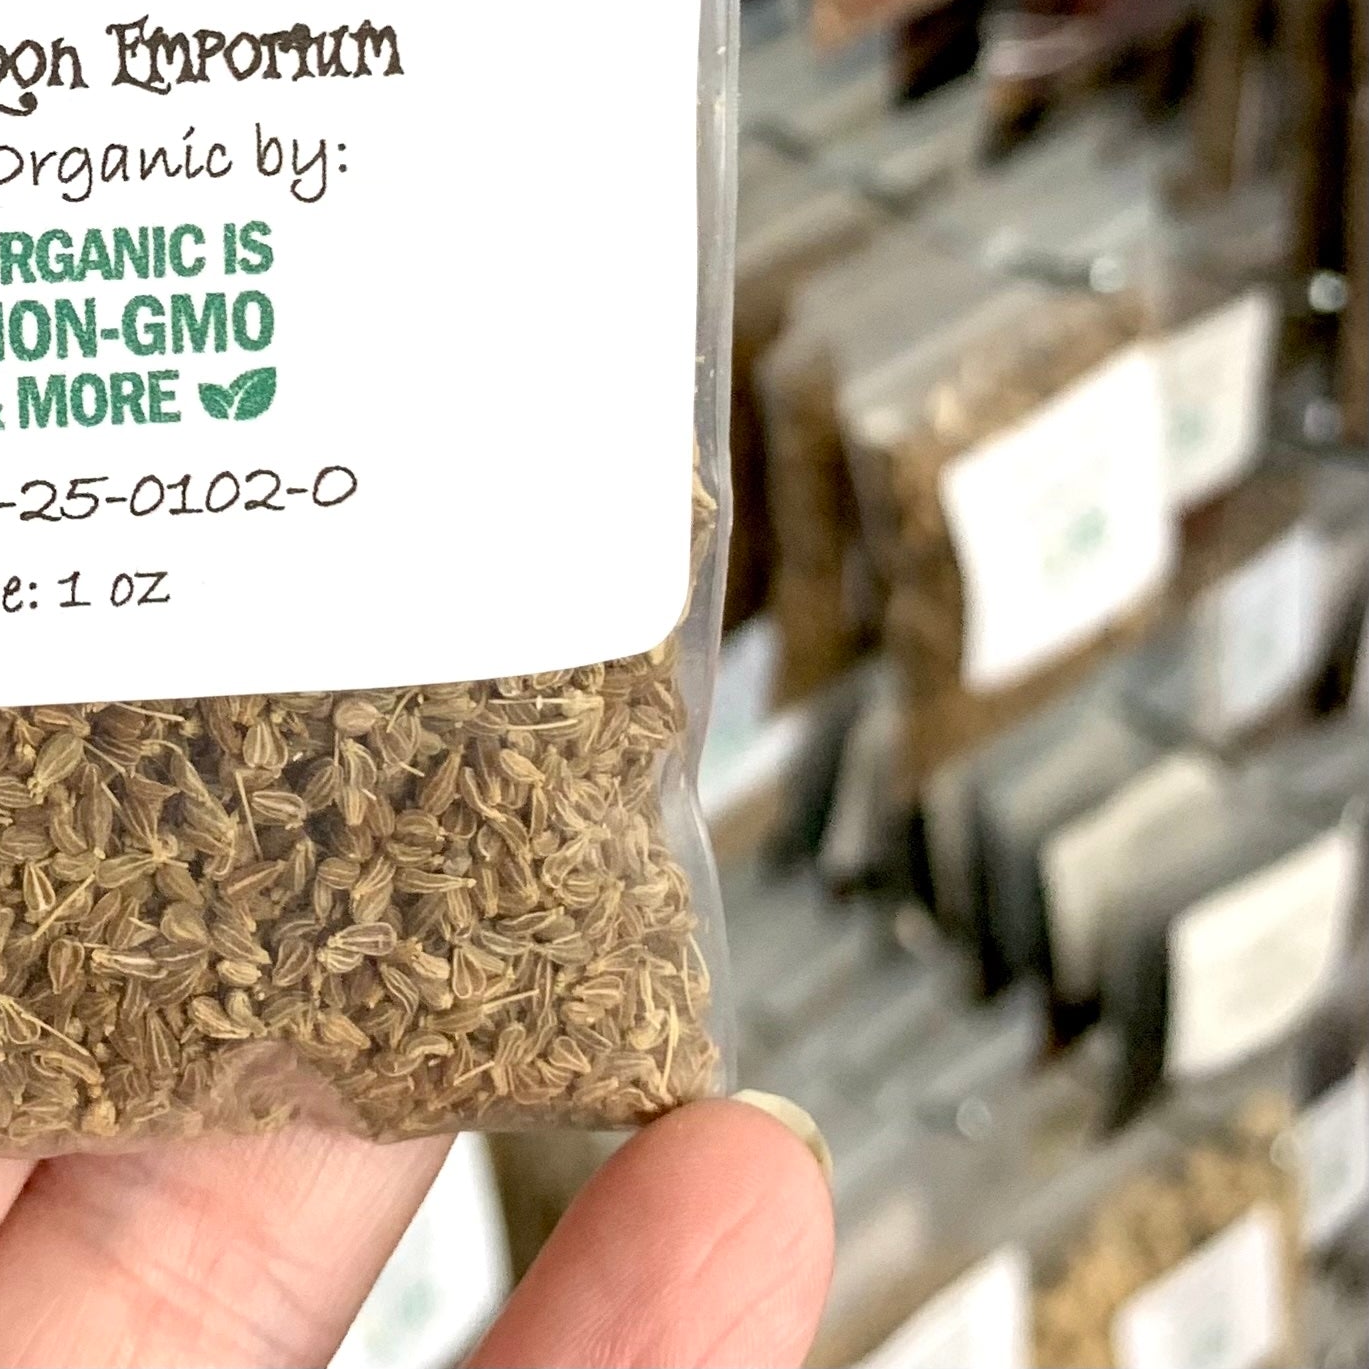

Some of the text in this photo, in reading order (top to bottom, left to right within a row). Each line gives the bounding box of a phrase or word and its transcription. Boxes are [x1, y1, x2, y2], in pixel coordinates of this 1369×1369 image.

[255, 122, 347, 204] by:
[223, 220, 274, 275] IS
[17, 369, 181, 430] MORE
[57, 571, 91, 608] 1
[109, 571, 171, 608] oz
